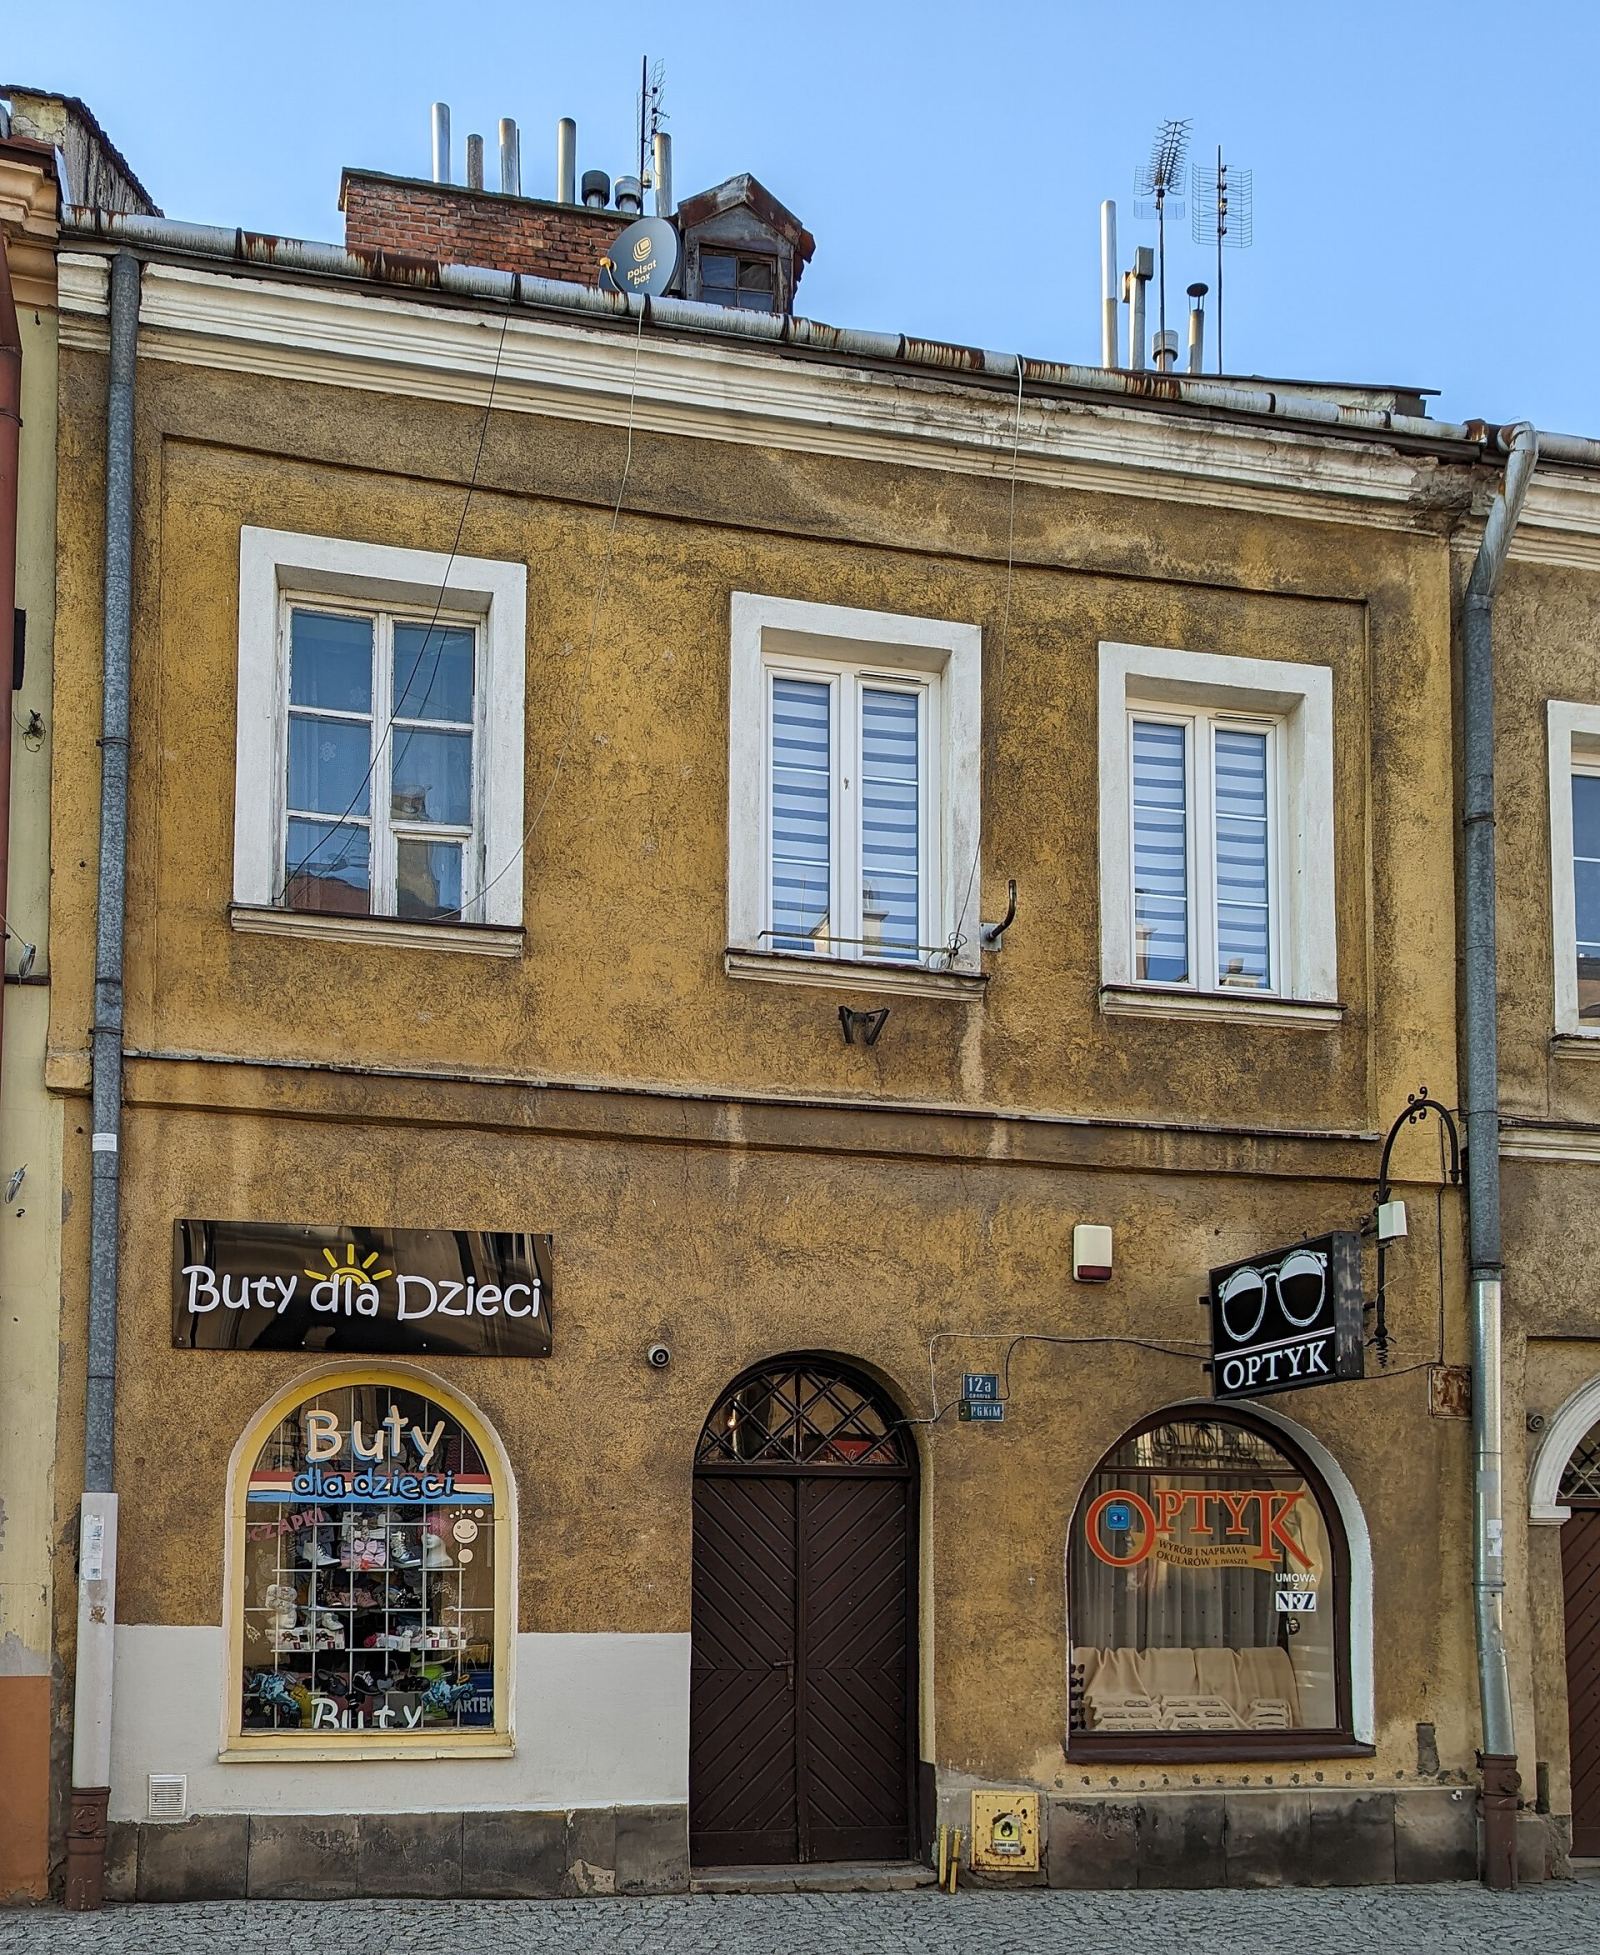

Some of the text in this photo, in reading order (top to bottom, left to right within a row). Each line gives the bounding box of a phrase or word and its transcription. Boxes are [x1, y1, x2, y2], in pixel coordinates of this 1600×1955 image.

[627, 260, 657, 281] polsat
[633, 273, 651, 285] box
[181, 1265, 541, 1321] Buty dla Dzieci
[1223, 1340, 1330, 1389] OPTYK
[968, 1377, 992, 1393] 12a
[305, 1405, 445, 1472] Buty
[294, 1467, 454, 1498] dla dzieci
[250, 1507, 325, 1542] CZAPKI
[1085, 1489, 1314, 1568] OPTYK
[1156, 1550, 1210, 1567] OKULARÓW
[1159, 1540, 1193, 1556] WYRÓB
[1200, 1546, 1247, 1556] NAPRAWA
[1275, 1573, 1317, 1583] UMOWA
[311, 1698, 422, 1729] Buty
